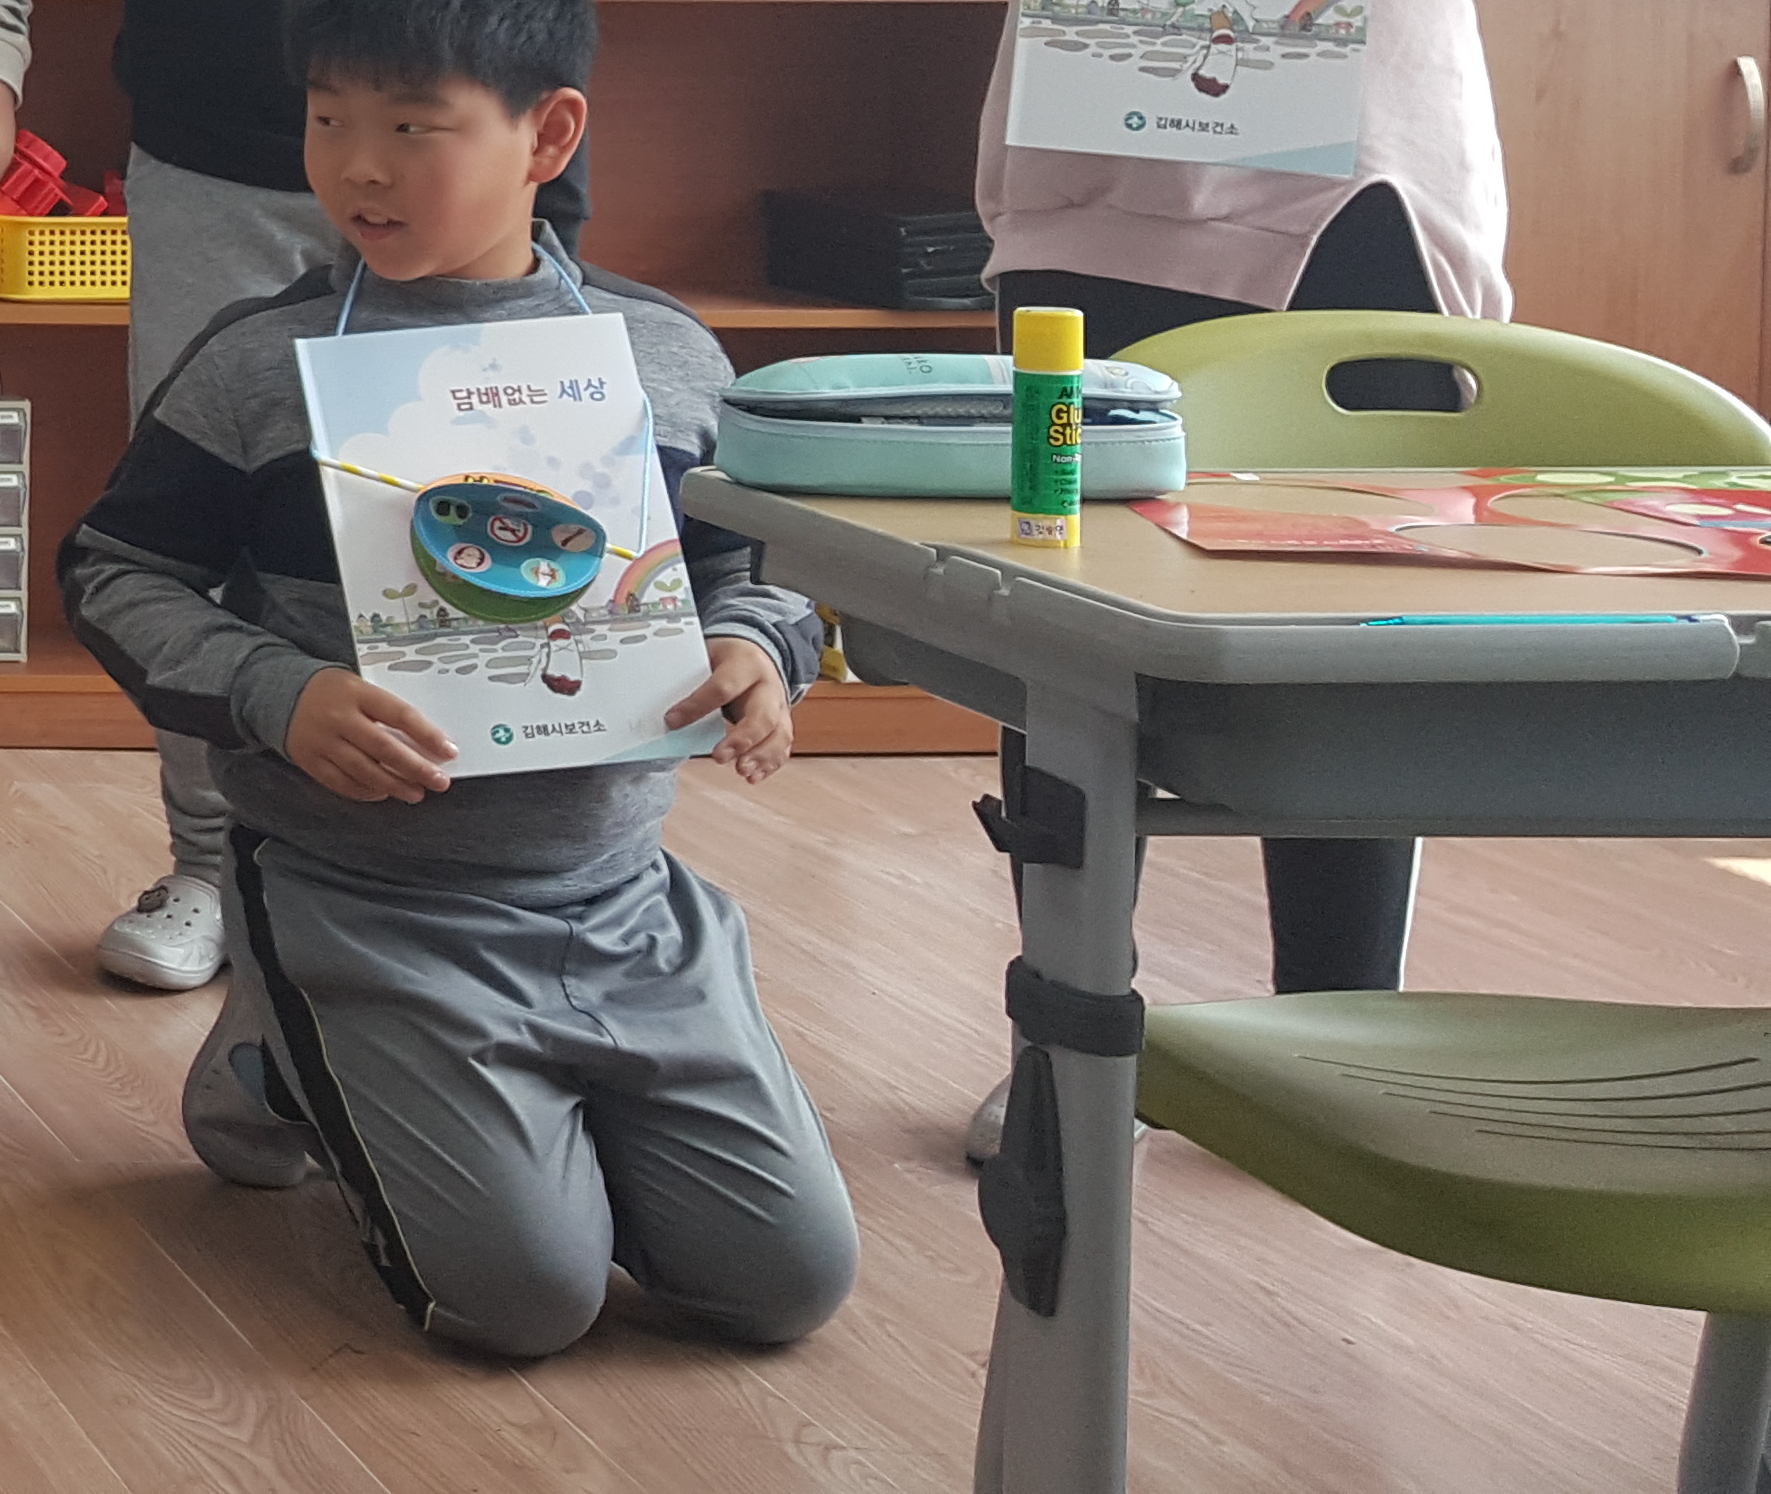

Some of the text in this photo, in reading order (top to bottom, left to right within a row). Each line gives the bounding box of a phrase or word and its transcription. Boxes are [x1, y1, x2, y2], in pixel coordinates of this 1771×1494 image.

[1156, 115, 1239, 136] 김해시보건소
[451, 377, 607, 412] 담배없는 세상
[1051, 403, 1082, 425] Glu
[1049, 425, 1082, 446] Stic
[522, 720, 607, 740] 김해시보건소
